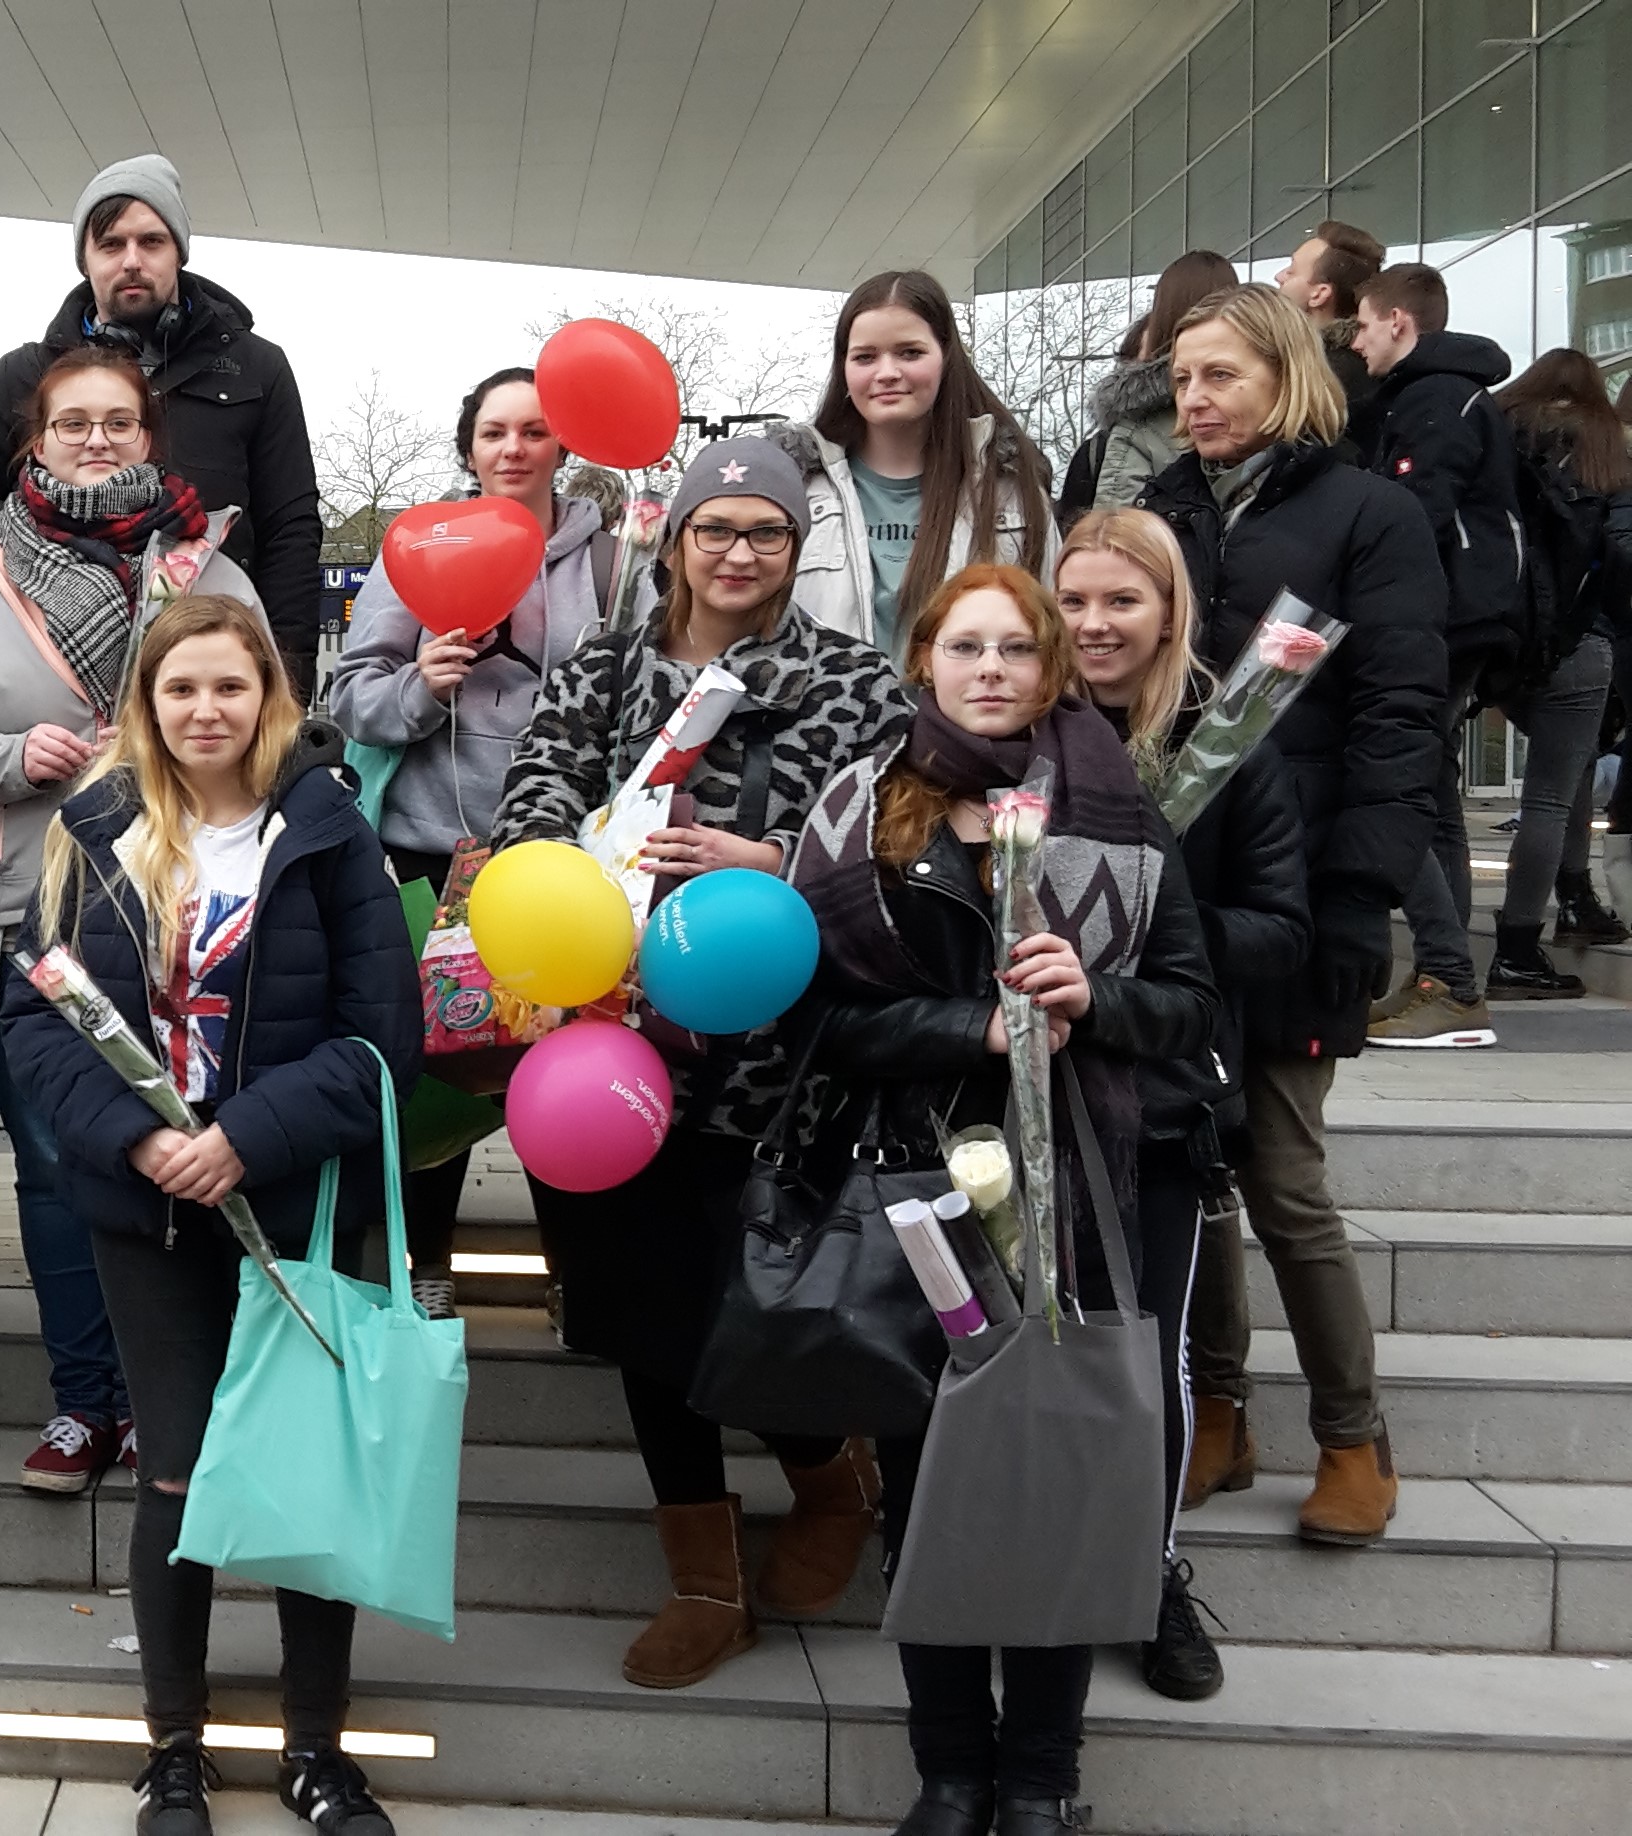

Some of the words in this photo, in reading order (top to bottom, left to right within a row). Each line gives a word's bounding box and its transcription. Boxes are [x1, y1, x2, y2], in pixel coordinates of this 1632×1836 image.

[327, 570, 342, 587] U
[672, 899, 692, 955] verdient
[609, 1079, 656, 1126] verdient
